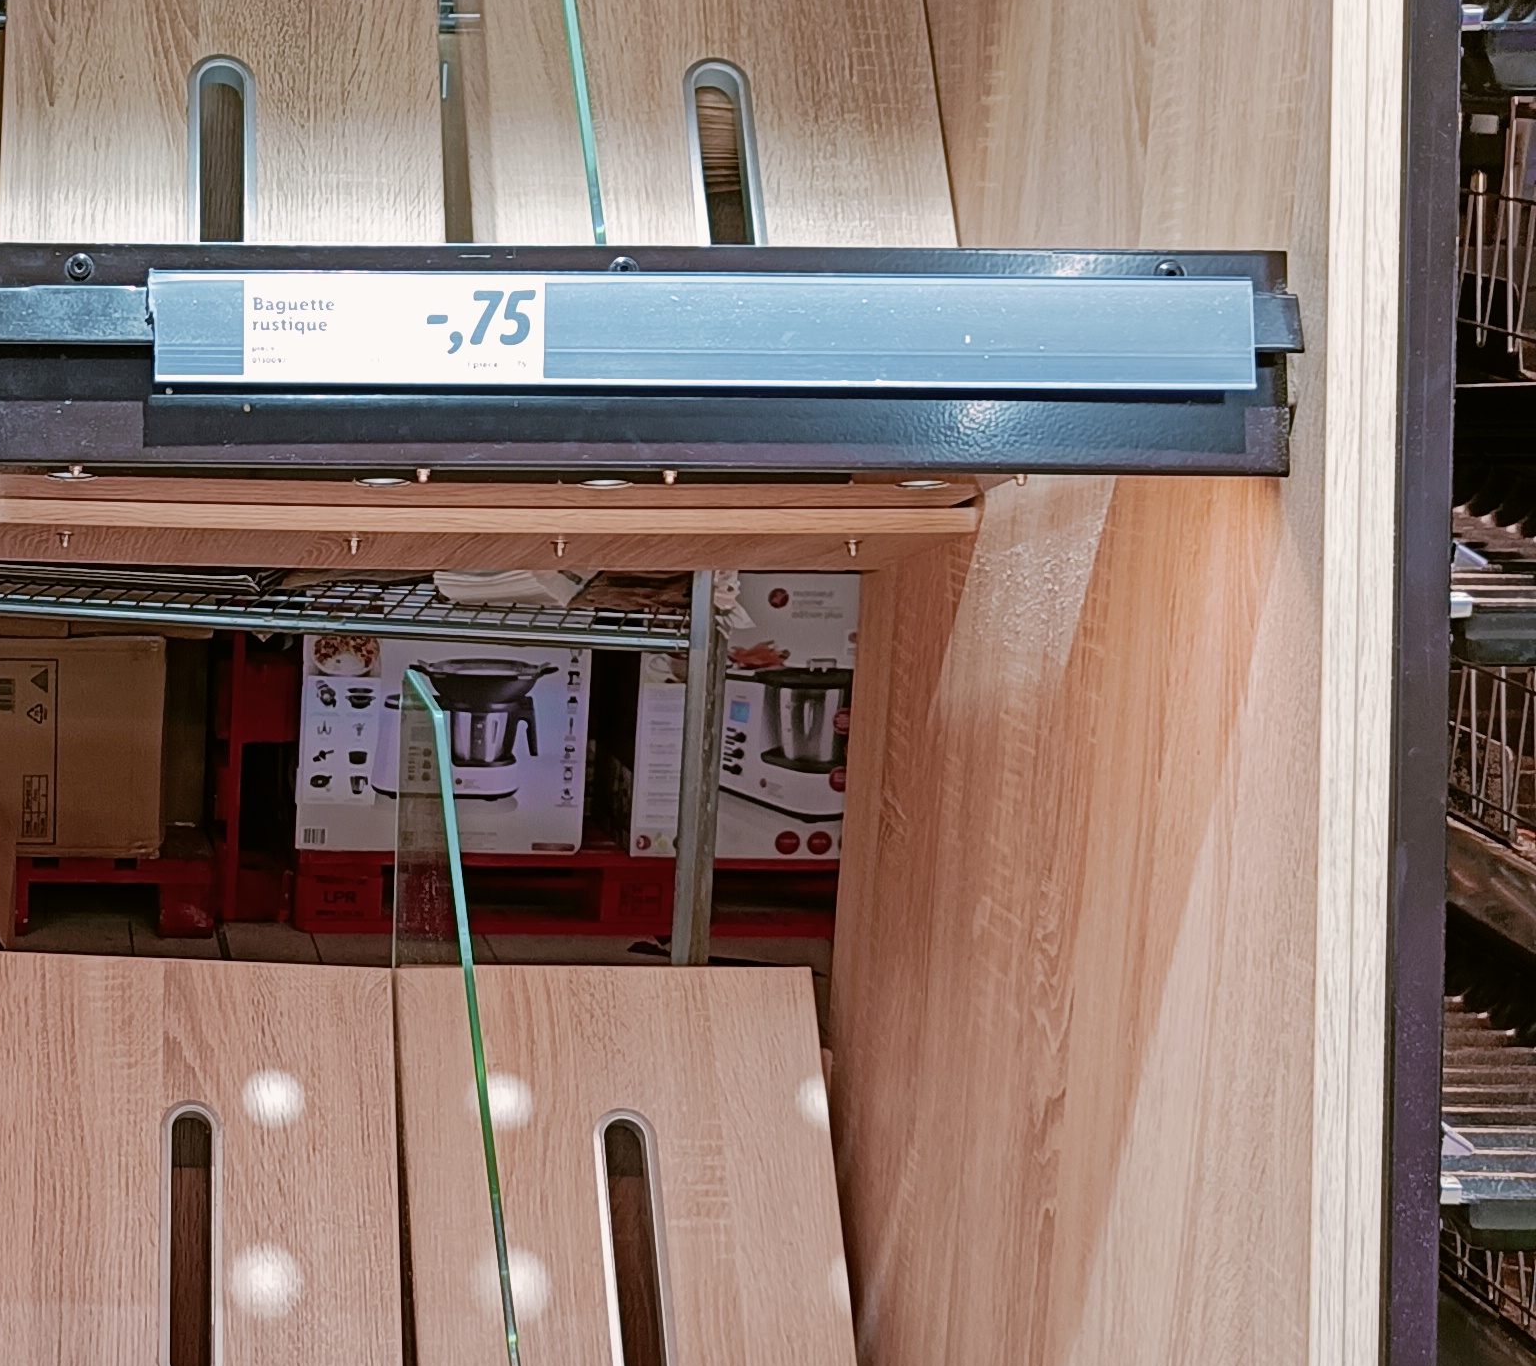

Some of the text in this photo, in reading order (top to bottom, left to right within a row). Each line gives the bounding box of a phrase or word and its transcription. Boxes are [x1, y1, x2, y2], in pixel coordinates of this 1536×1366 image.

[252, 296, 335, 315] Baguette
[252, 316, 328, 335] rustique
[426, 289, 537, 355] -,75
